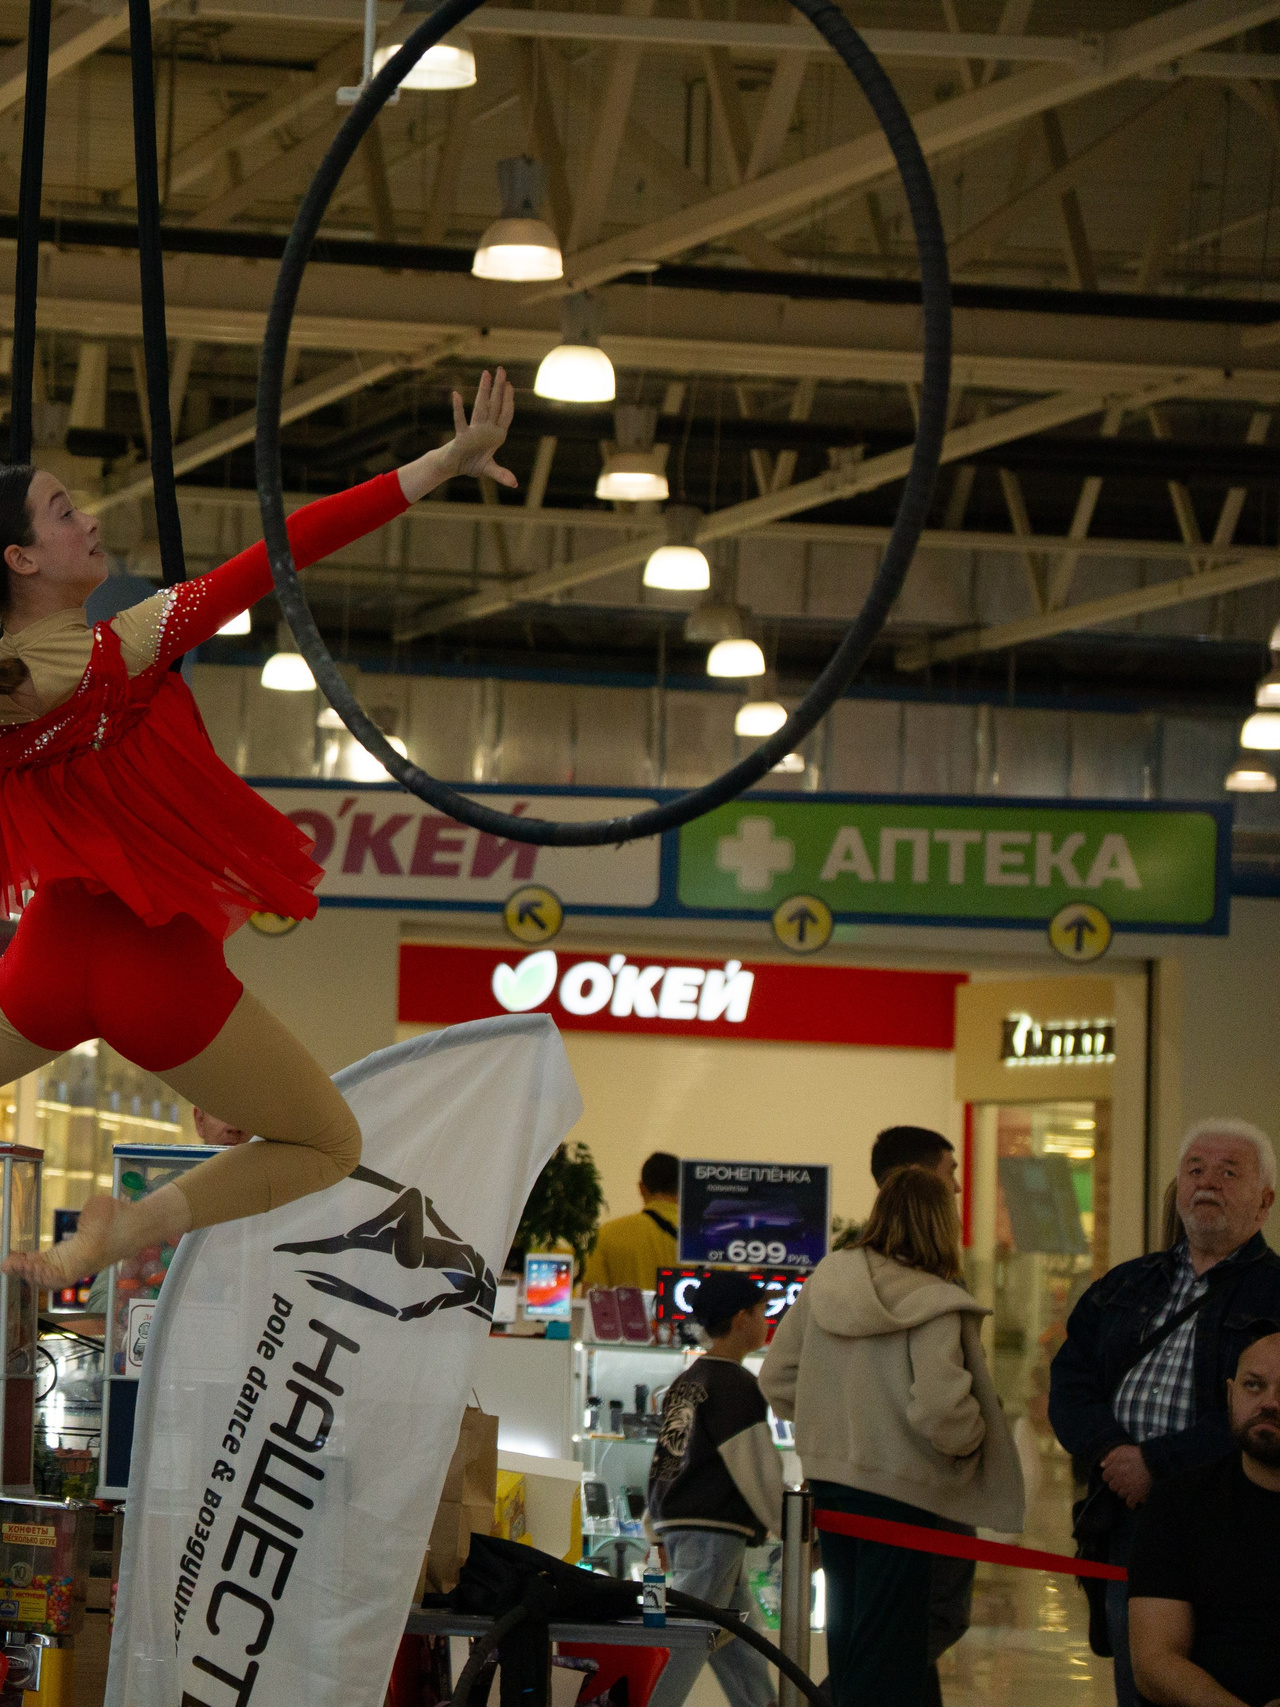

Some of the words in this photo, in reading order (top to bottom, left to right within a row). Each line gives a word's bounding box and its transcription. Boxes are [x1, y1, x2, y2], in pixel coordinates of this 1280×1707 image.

[820, 825, 1143, 891] АПТЕКА
[558, 953, 755, 1023] О'КЕЙ
[695, 1165, 811, 1183] БРОНЕПЛЁНКА
[727, 1240, 787, 1264] 699
[257, 1293, 293, 1360] pole
[222, 1364, 268, 1455] dance
[211, 1459, 236, 1482] &
[8, 1525, 49, 1535] КОНФЕТЫ
[181, 1318, 361, 1707] НАШЕСТ
[3, 1534, 38, 1545] НЕСКОЛЬКО
[39, 1538, 56, 1546] ШТУК
